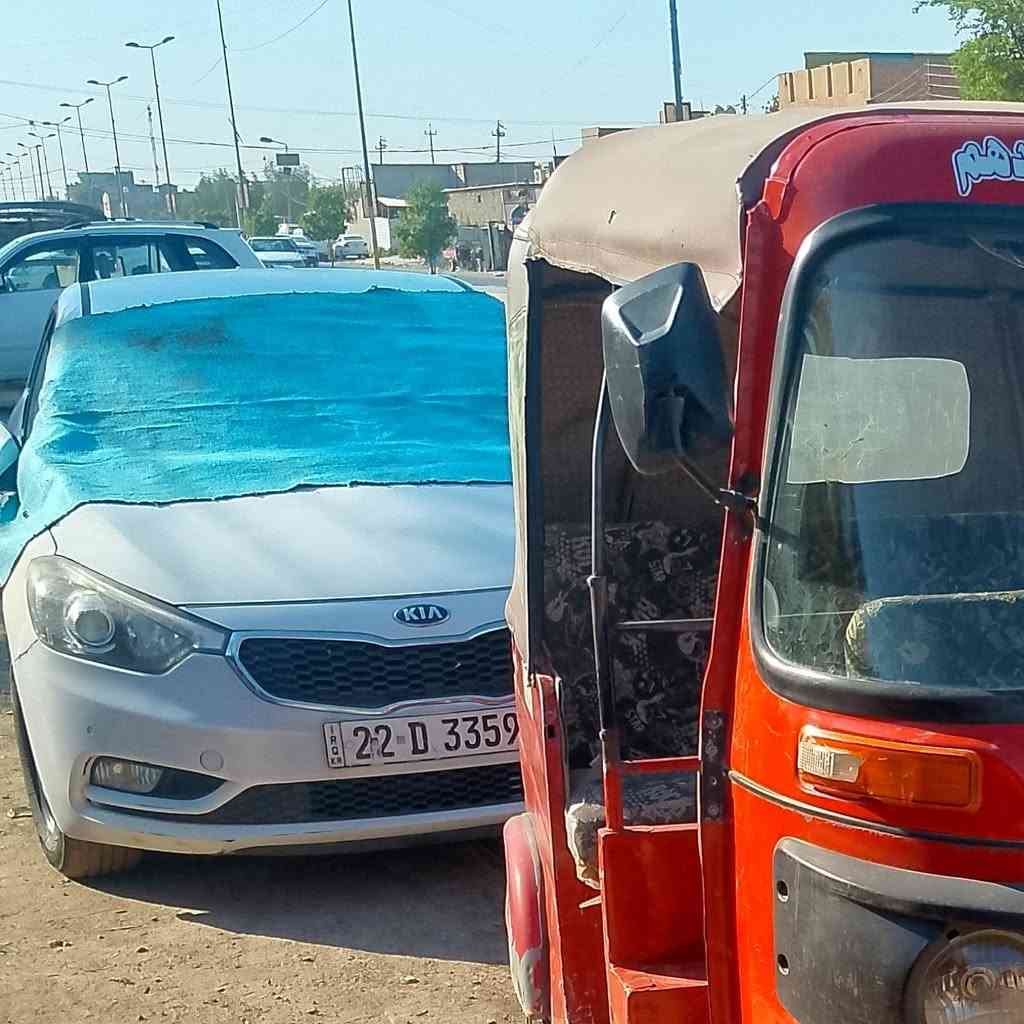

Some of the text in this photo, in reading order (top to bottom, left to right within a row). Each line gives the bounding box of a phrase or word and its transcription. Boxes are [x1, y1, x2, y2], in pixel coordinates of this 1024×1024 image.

[403, 606, 444, 621] KIA
[353, 712, 519, 760] 22 D 3359
